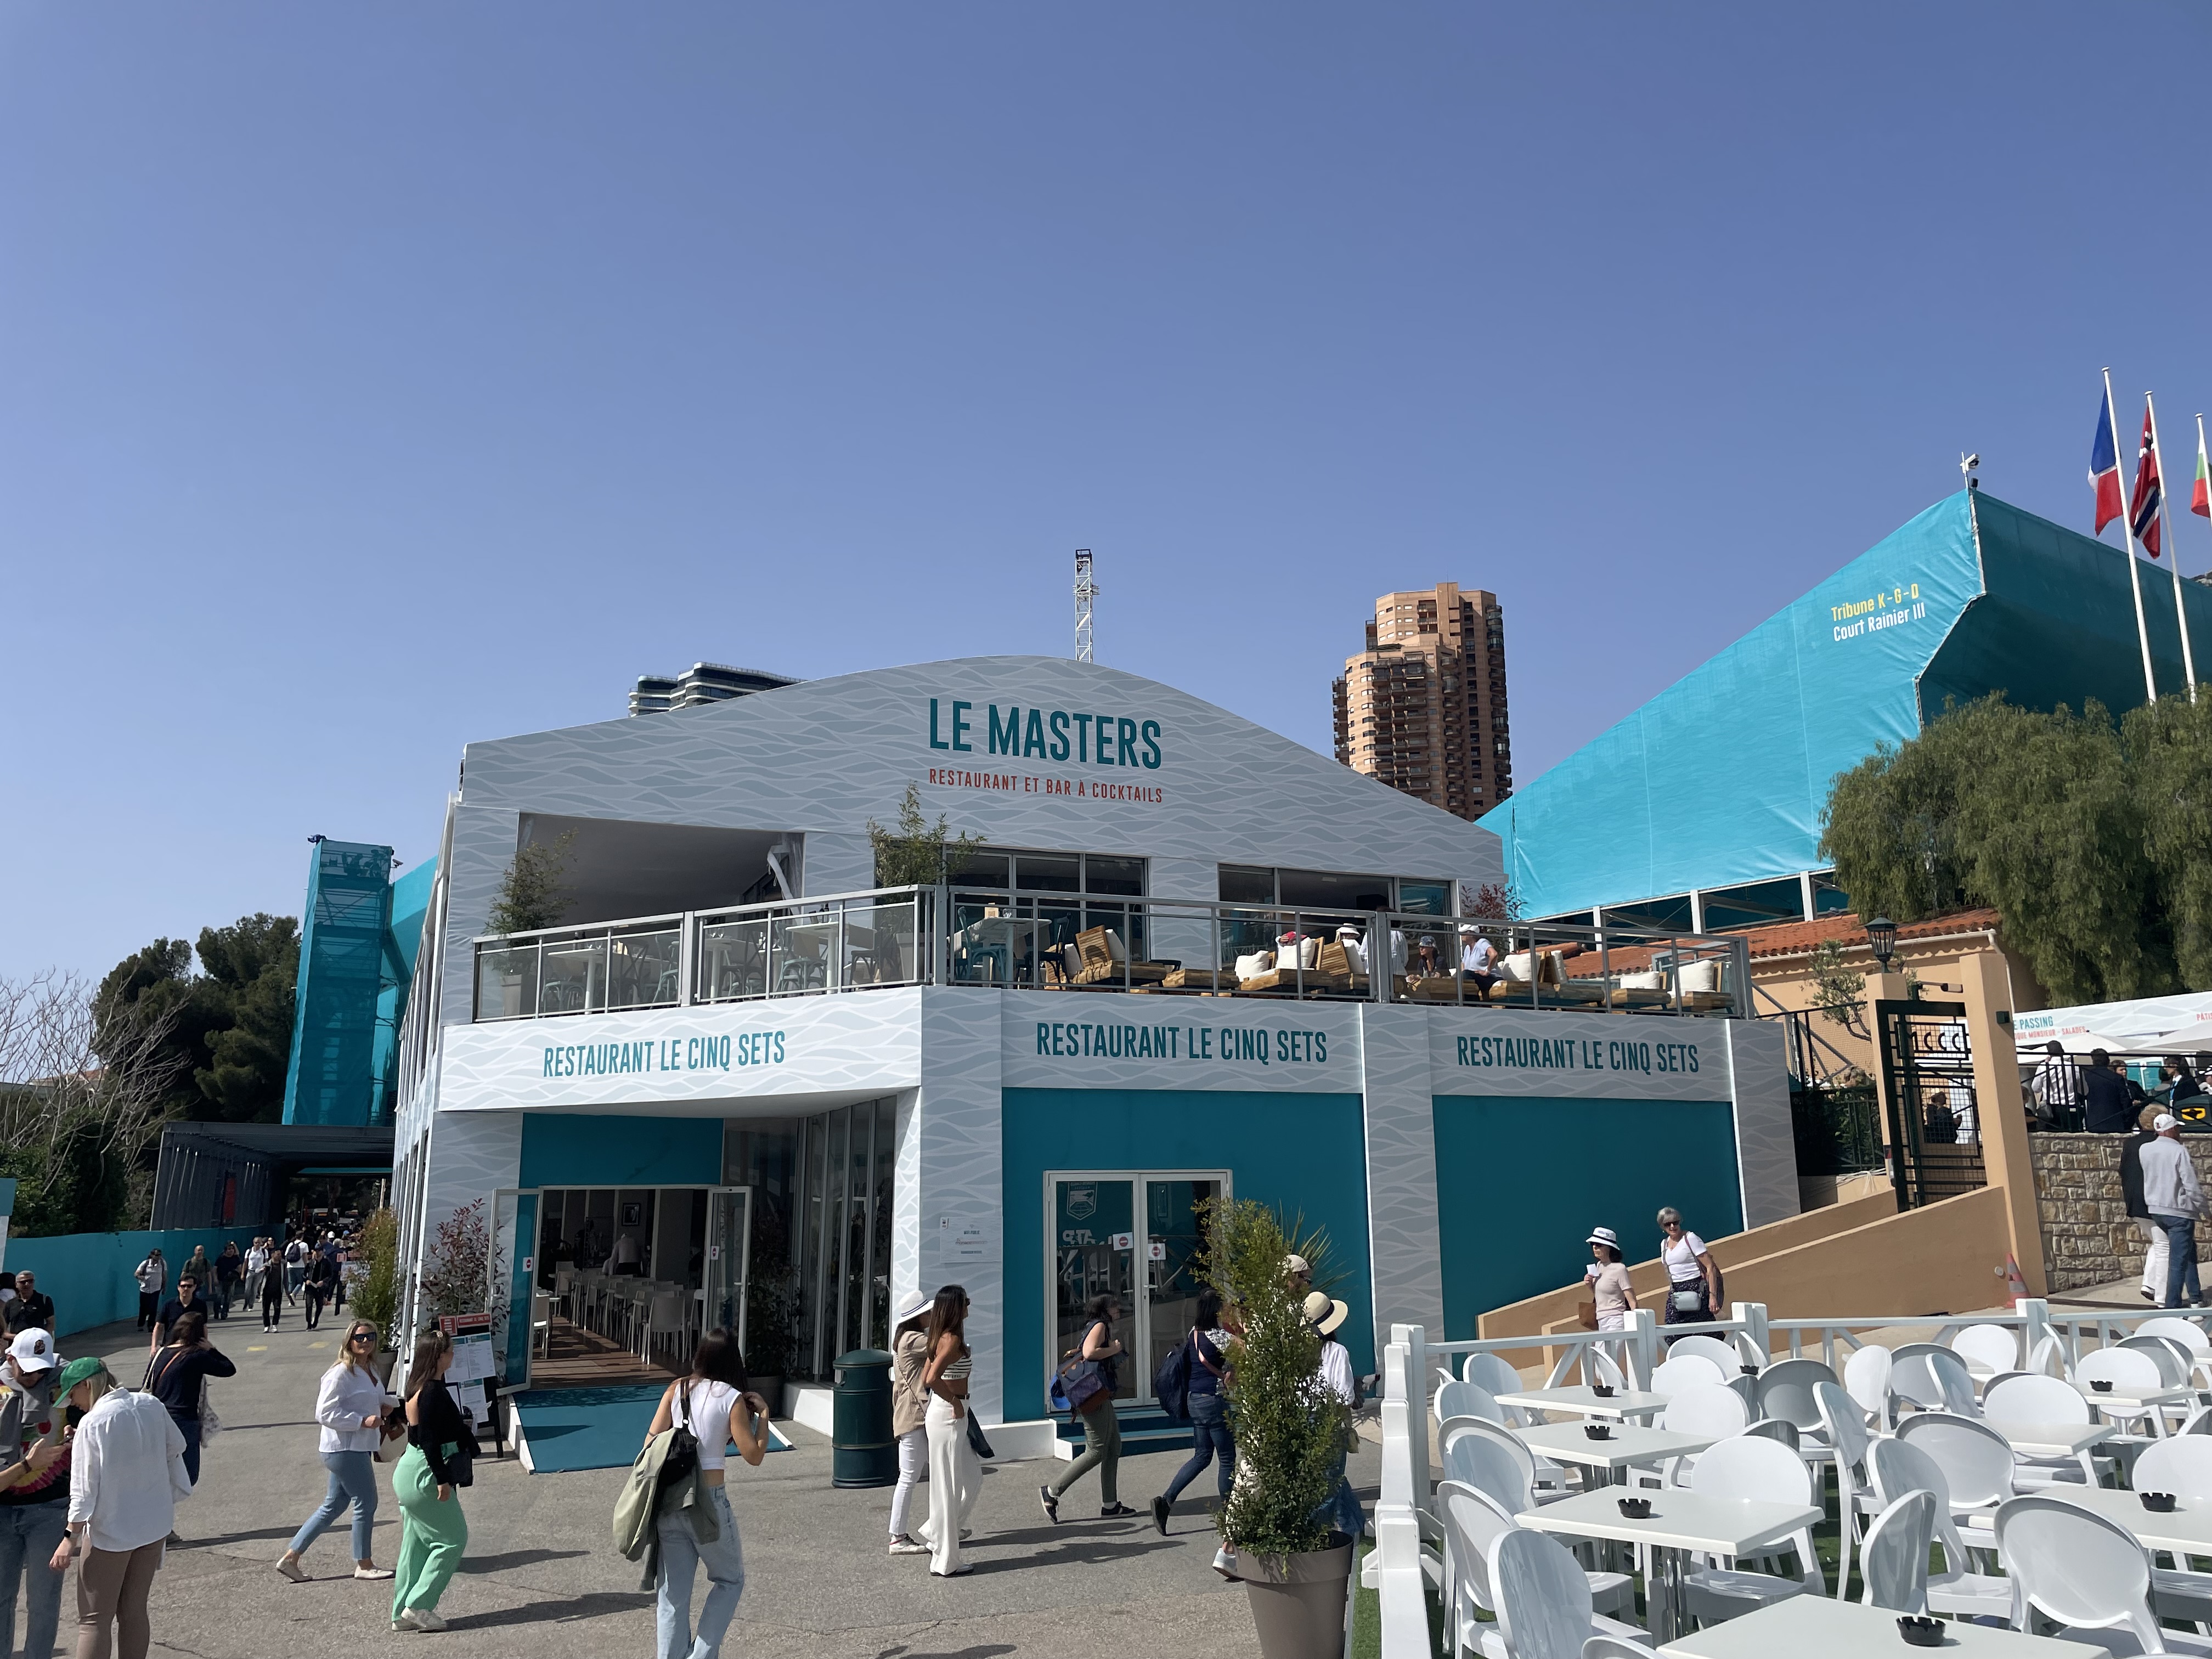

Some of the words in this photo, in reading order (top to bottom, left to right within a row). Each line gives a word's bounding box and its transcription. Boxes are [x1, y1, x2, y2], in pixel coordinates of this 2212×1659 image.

[1831, 599, 1875, 622] Tribune
[1877, 592, 1886, 608] K
[1894, 588, 1902, 603] G
[1833, 619, 1864, 642] Court
[1867, 608, 1910, 632] Rainier
[1912, 602, 1926, 620] III
[930, 698, 972, 752] LE
[989, 704, 1162, 769] MASTERS
[929, 769, 1018, 791] RESTAURANT
[1024, 776, 1040, 793] ET
[1046, 779, 1071, 795] BAR
[1078, 780, 1085, 797] À
[1092, 782, 1163, 803] COCKTAILS
[2015, 1032, 2027, 1041] OQUE
[2028, 1029, 2056, 1039] MONSIEUR
[2061, 1026, 2086, 1035] SALADES
[2019, 1016, 2053, 1030] PASSING
[543, 1041, 654, 1077] RESTAURANT
[661, 1039, 681, 1071] LE
[687, 1035, 731, 1071] CINQ
[738, 1031, 785, 1066] SETS
[1036, 1022, 1180, 1059] RESTAURANT
[1188, 1026, 1213, 1059] LE
[1220, 1028, 1269, 1066] CINQ
[1277, 1030, 1328, 1063] SETS
[1457, 1036, 1576, 1069] RESTAURANT
[1582, 1040, 1604, 1070] LE
[1609, 1041, 1651, 1076] CINQ
[1656, 1043, 1700, 1073] SETS
